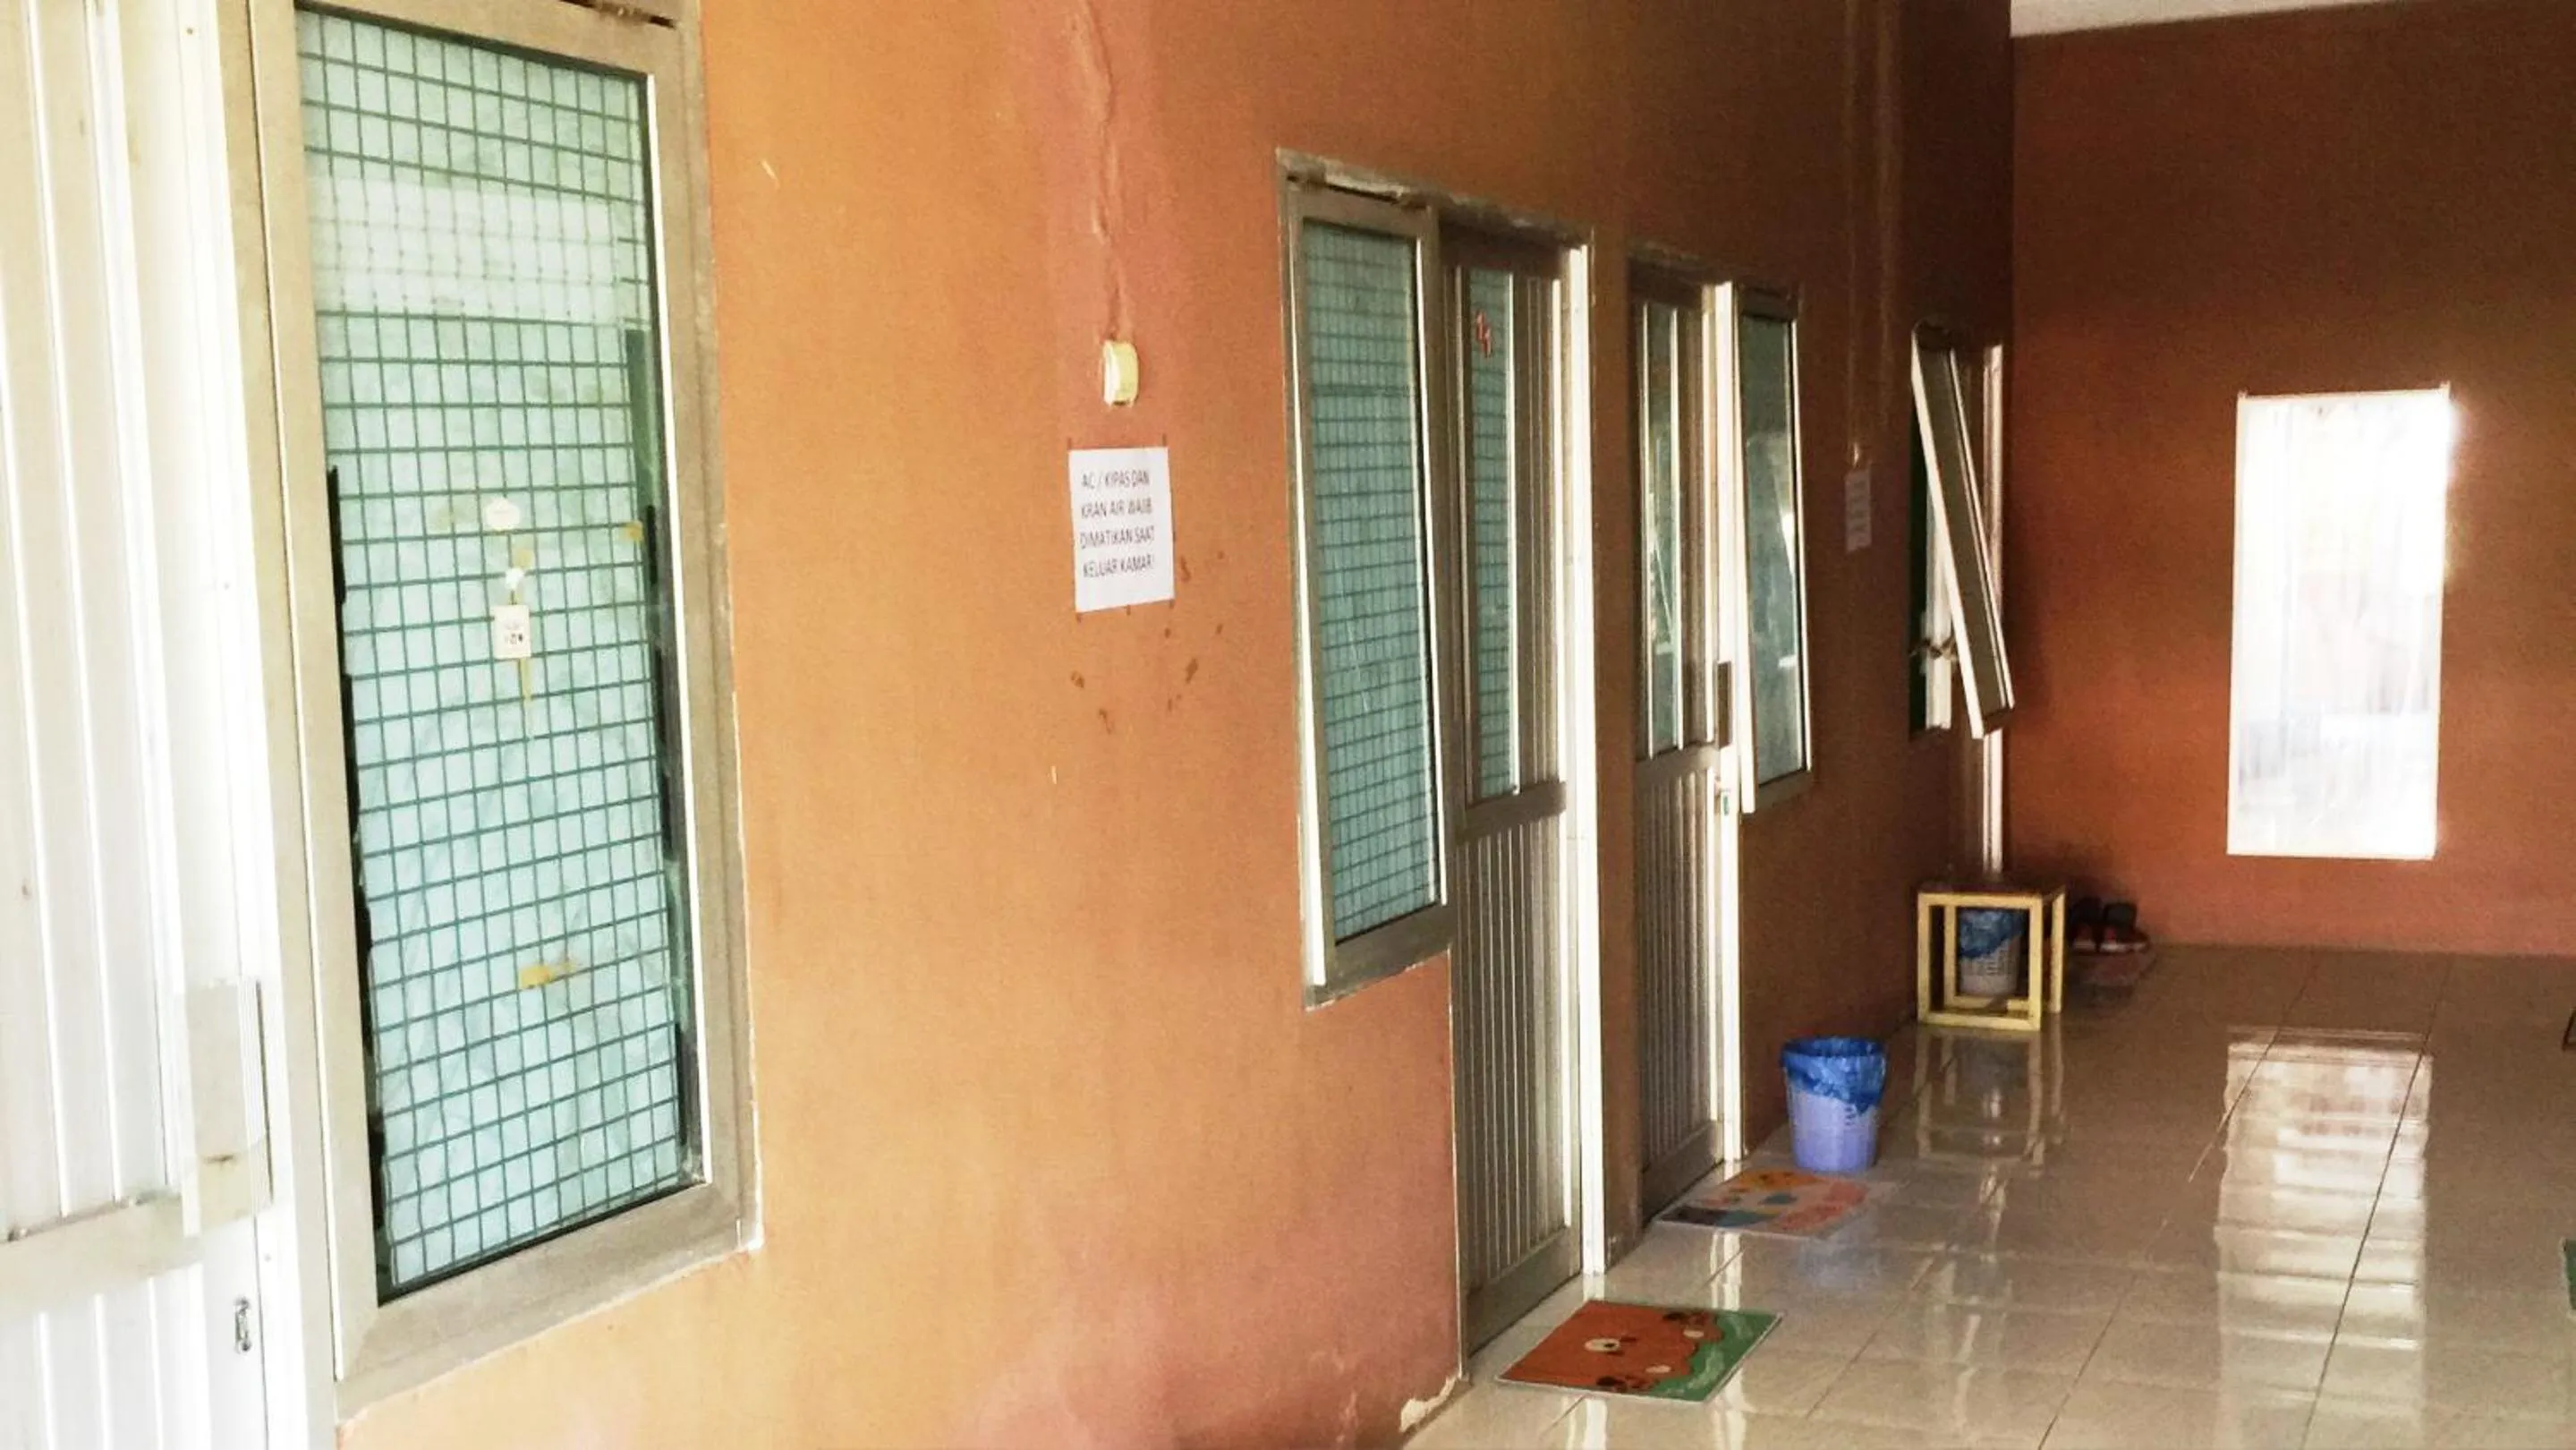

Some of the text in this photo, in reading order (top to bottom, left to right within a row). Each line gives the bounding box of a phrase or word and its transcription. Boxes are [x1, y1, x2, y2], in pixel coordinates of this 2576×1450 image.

[1104, 470, 1130, 489] KIPAS
[1132, 469, 1150, 488] DAN
[1081, 500, 1107, 518] KRAN
[1109, 499, 1126, 516] AIR
[1079, 525, 1154, 549] DIMATIKAN SAAT
[1083, 558, 1118, 578] KELUAR
